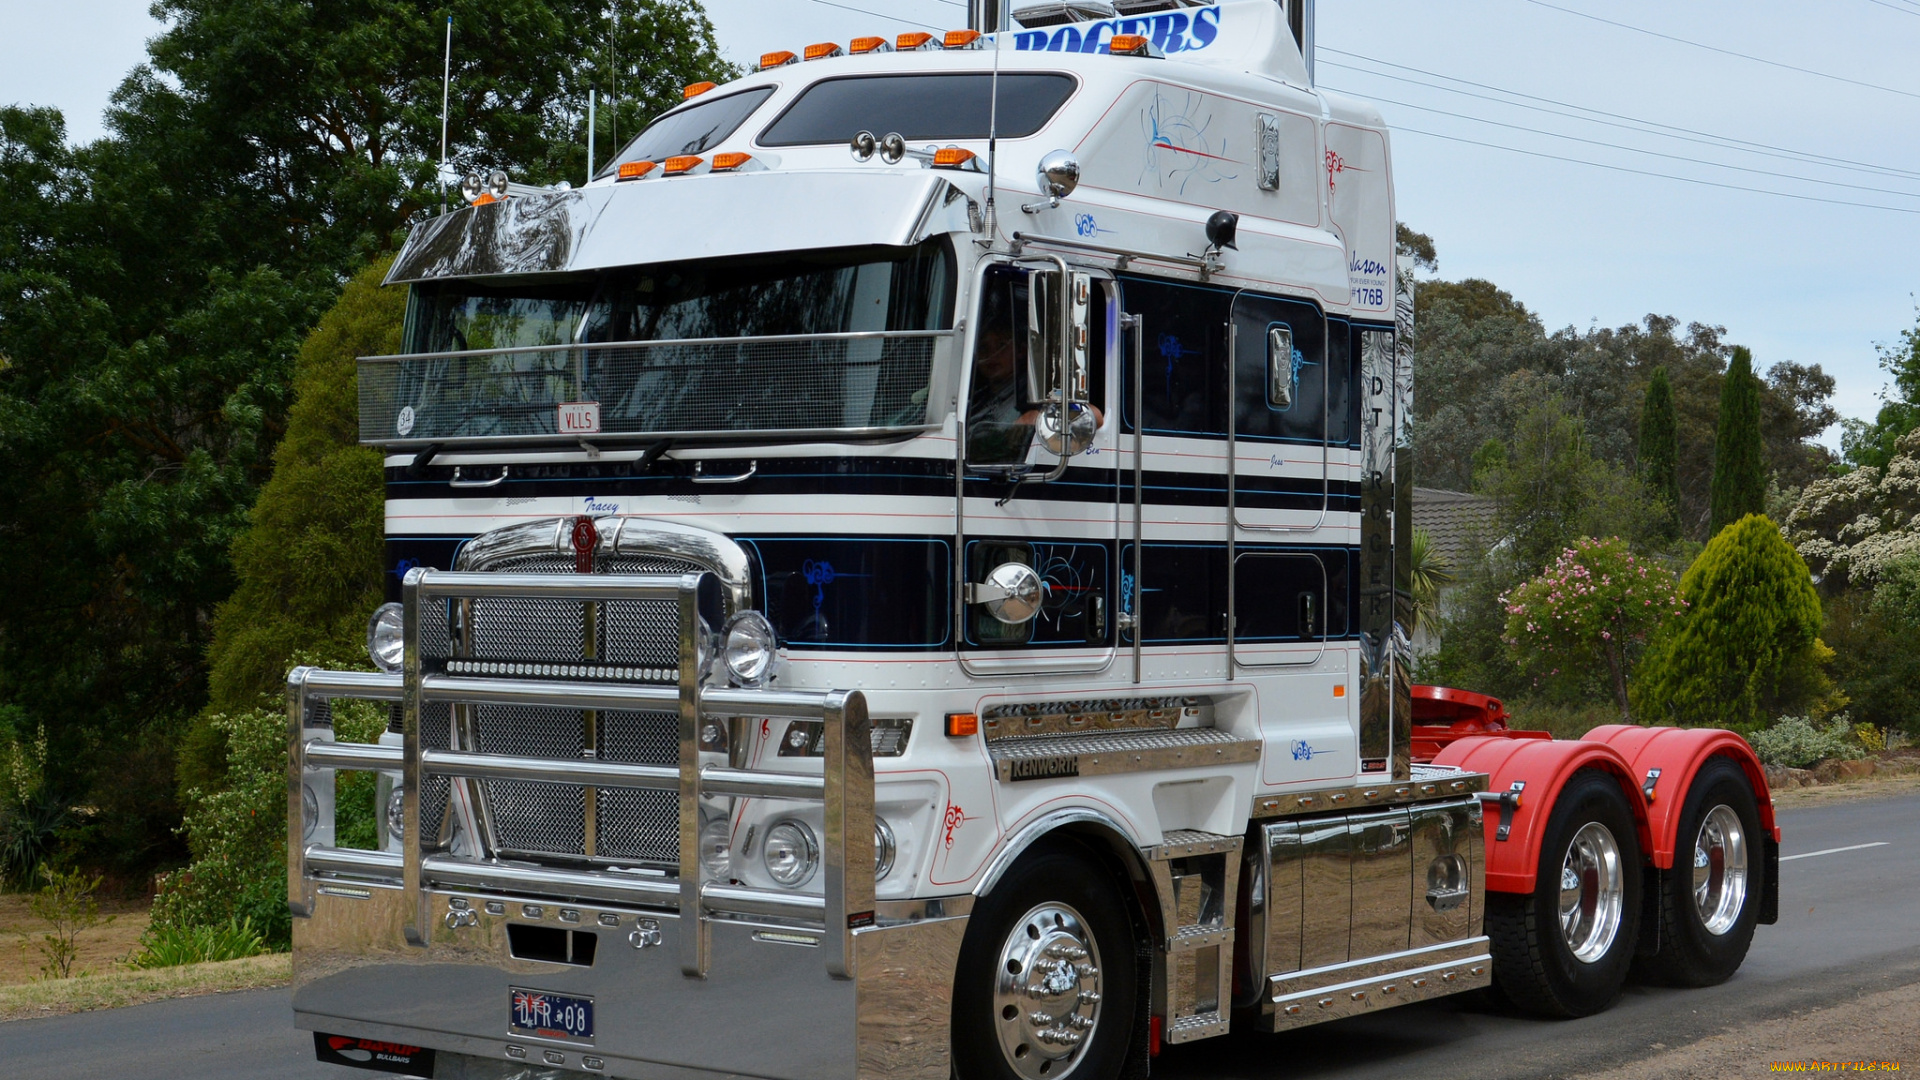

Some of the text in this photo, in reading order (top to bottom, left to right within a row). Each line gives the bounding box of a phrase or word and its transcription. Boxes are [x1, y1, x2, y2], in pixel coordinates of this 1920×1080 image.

[1349, 250, 1386, 276] Jason
[1351, 286, 1383, 306] #176B
[584, 496, 619, 515] Tracey
[1012, 757, 1079, 777] KENWORTH
[520, 999, 585, 1032] DTR 08
